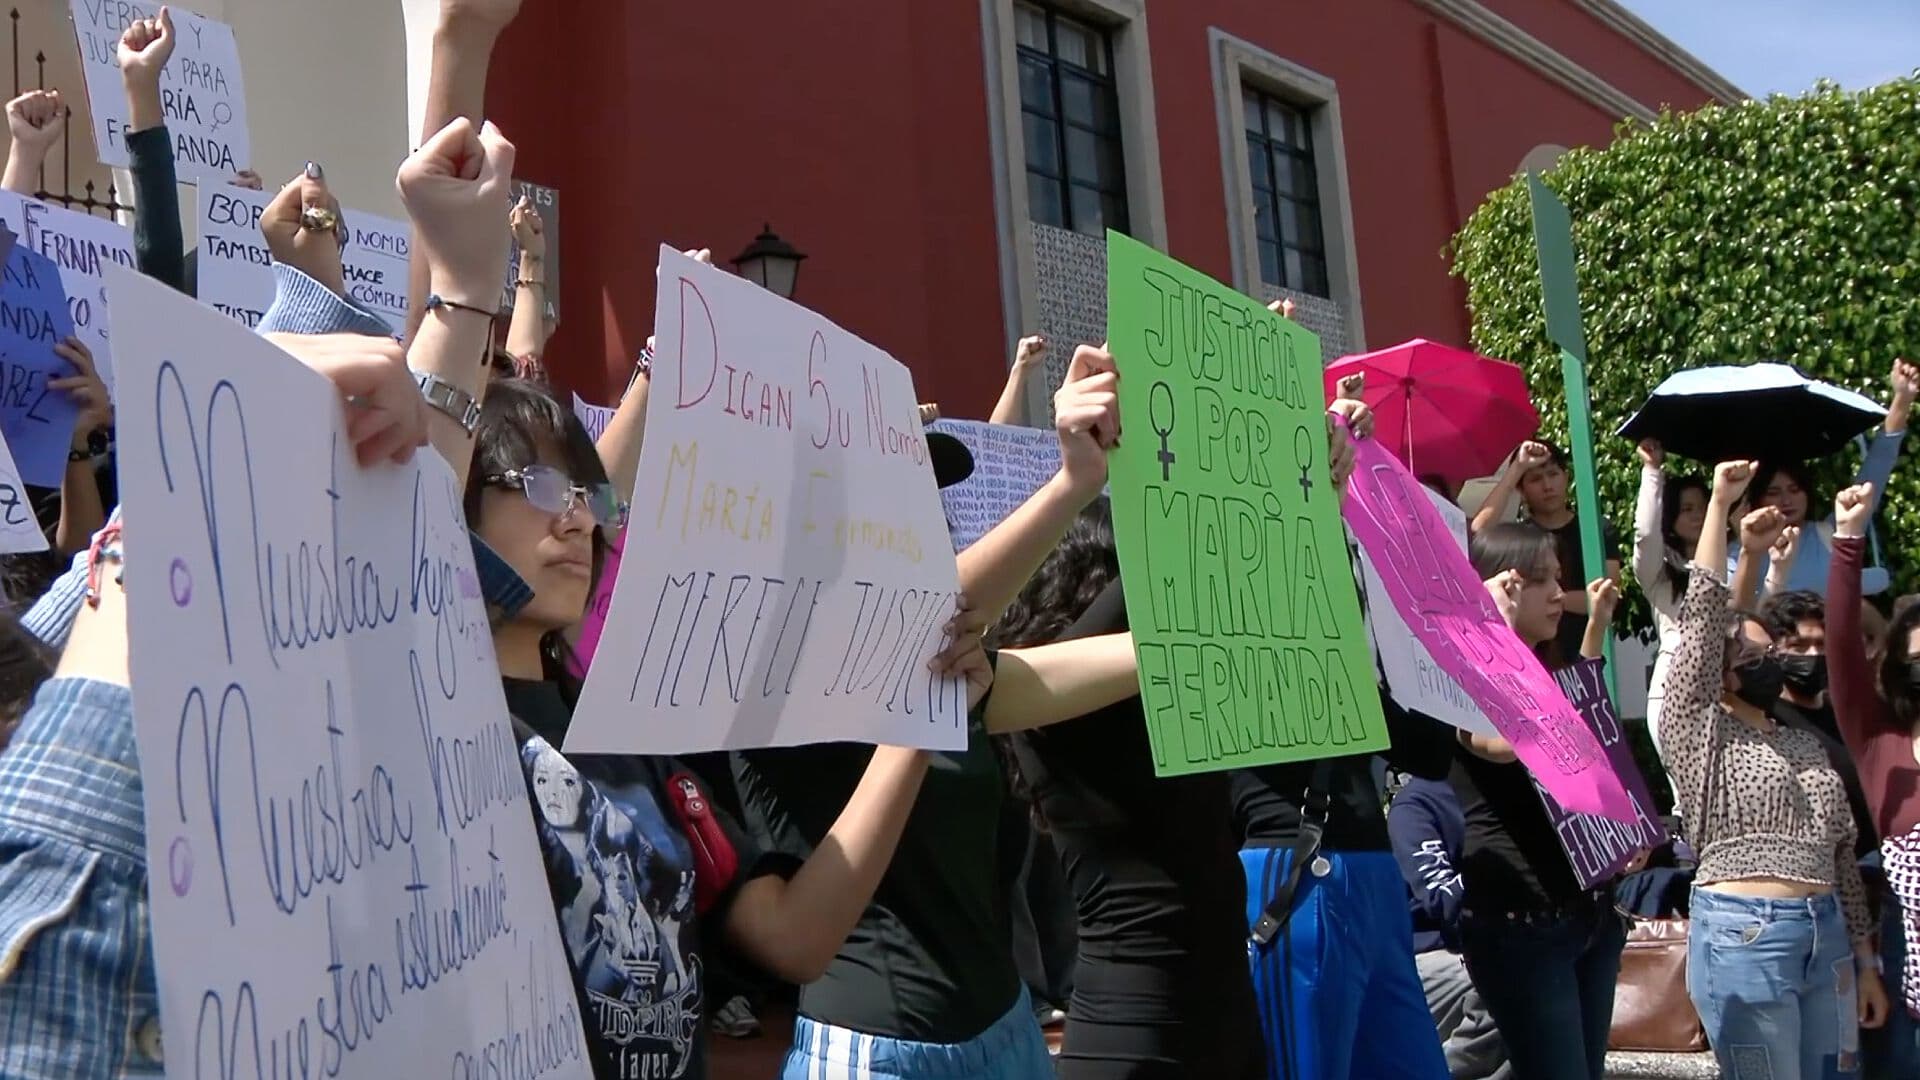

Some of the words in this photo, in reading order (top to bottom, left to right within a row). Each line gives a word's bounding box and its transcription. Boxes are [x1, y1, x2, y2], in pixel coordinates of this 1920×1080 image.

[189, 23, 202, 49] Y
[181, 57, 230, 96] PARA
[162, 88, 202, 124] RÍA
[106, 118, 237, 173] FEANDA
[205, 235, 273, 266] TAMBI
[356, 229, 409, 256] NOMB
[1194, 386, 1272, 488] POR
[157, 359, 399, 670] Nuestra
[1138, 642, 1367, 768] FERNANDA
[175, 682, 412, 928] Nuestra
